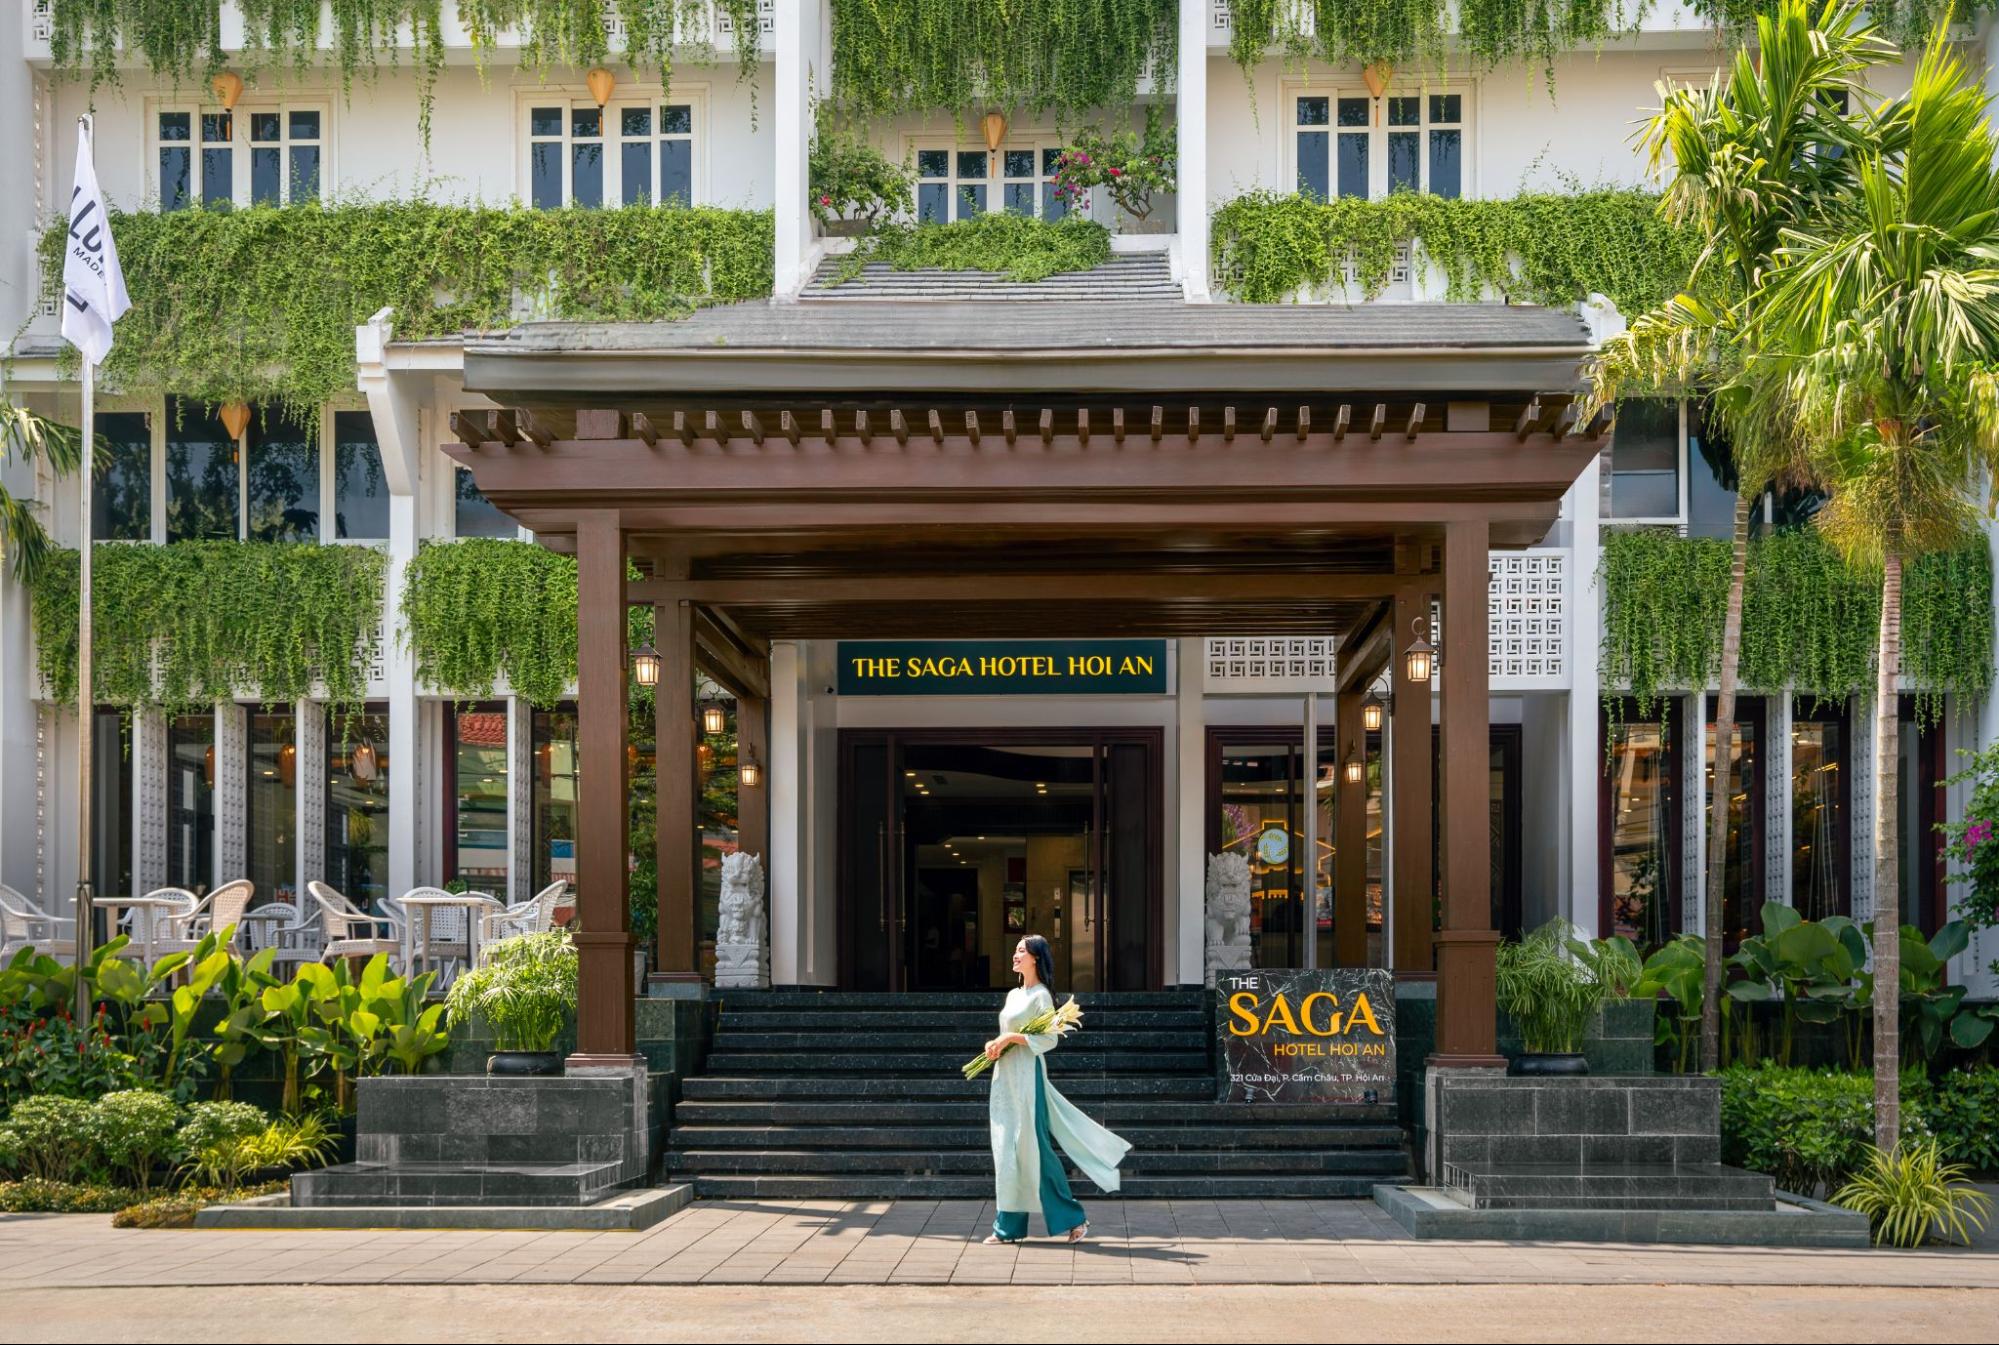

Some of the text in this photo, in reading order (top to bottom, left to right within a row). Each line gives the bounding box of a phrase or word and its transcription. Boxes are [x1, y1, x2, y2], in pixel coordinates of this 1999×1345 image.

[852, 656, 1153, 677] THE SAGA HOTEL HOI AN
[1230, 977, 1259, 989] THE
[1228, 991, 1385, 1037] SAGA
[1274, 1044, 1385, 1056] HOTEL HOI AN
[1230, 1073, 1244, 1082] 321
